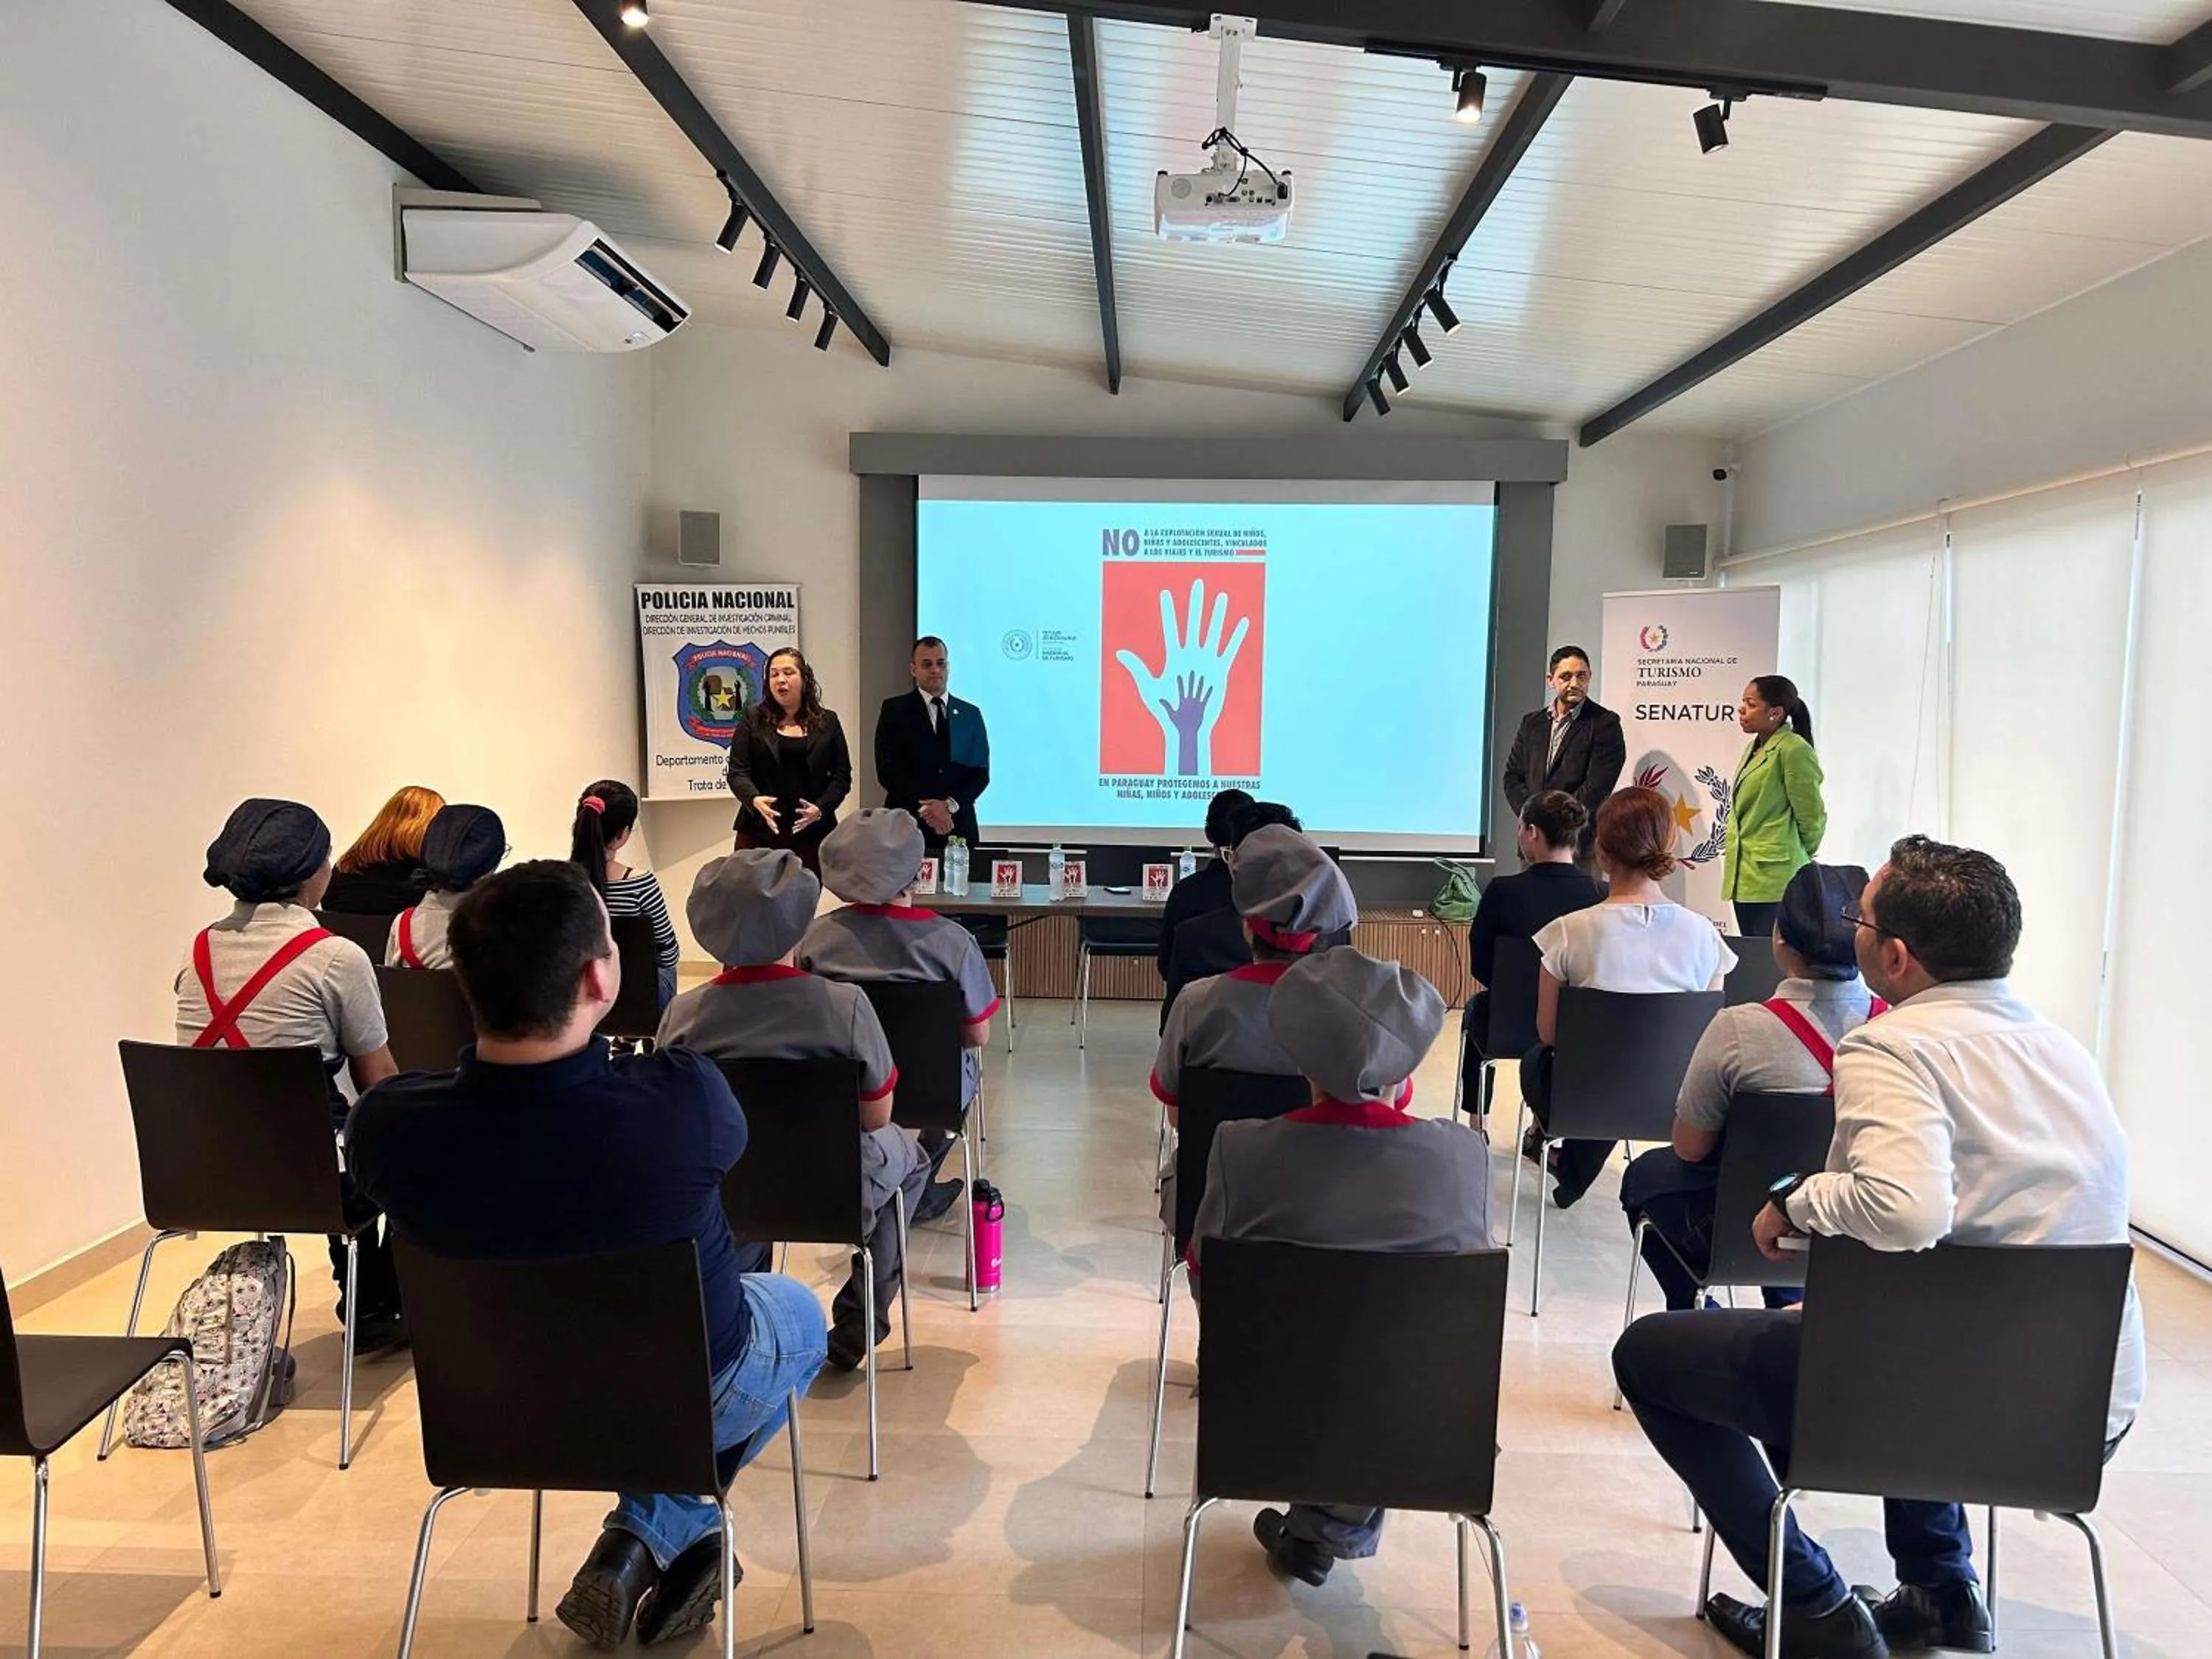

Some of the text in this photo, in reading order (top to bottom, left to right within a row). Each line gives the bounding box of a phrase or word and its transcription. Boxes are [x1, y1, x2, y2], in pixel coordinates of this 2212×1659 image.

[1102, 529, 1140, 556] NO
[641, 591, 796, 610] POLICIA NACIONAL
[1638, 666, 1702, 678] TURISMO
[1635, 703, 1736, 721] SENATUR
[655, 754, 723, 768] Departamento
[687, 779, 727, 790] Trata de
[1099, 779, 1261, 790] EN PARAGUAY PROTEGEMOS A NUESTRAS
[1173, 790, 1180, 799] Y
[1181, 790, 1215, 800] ADOLES
